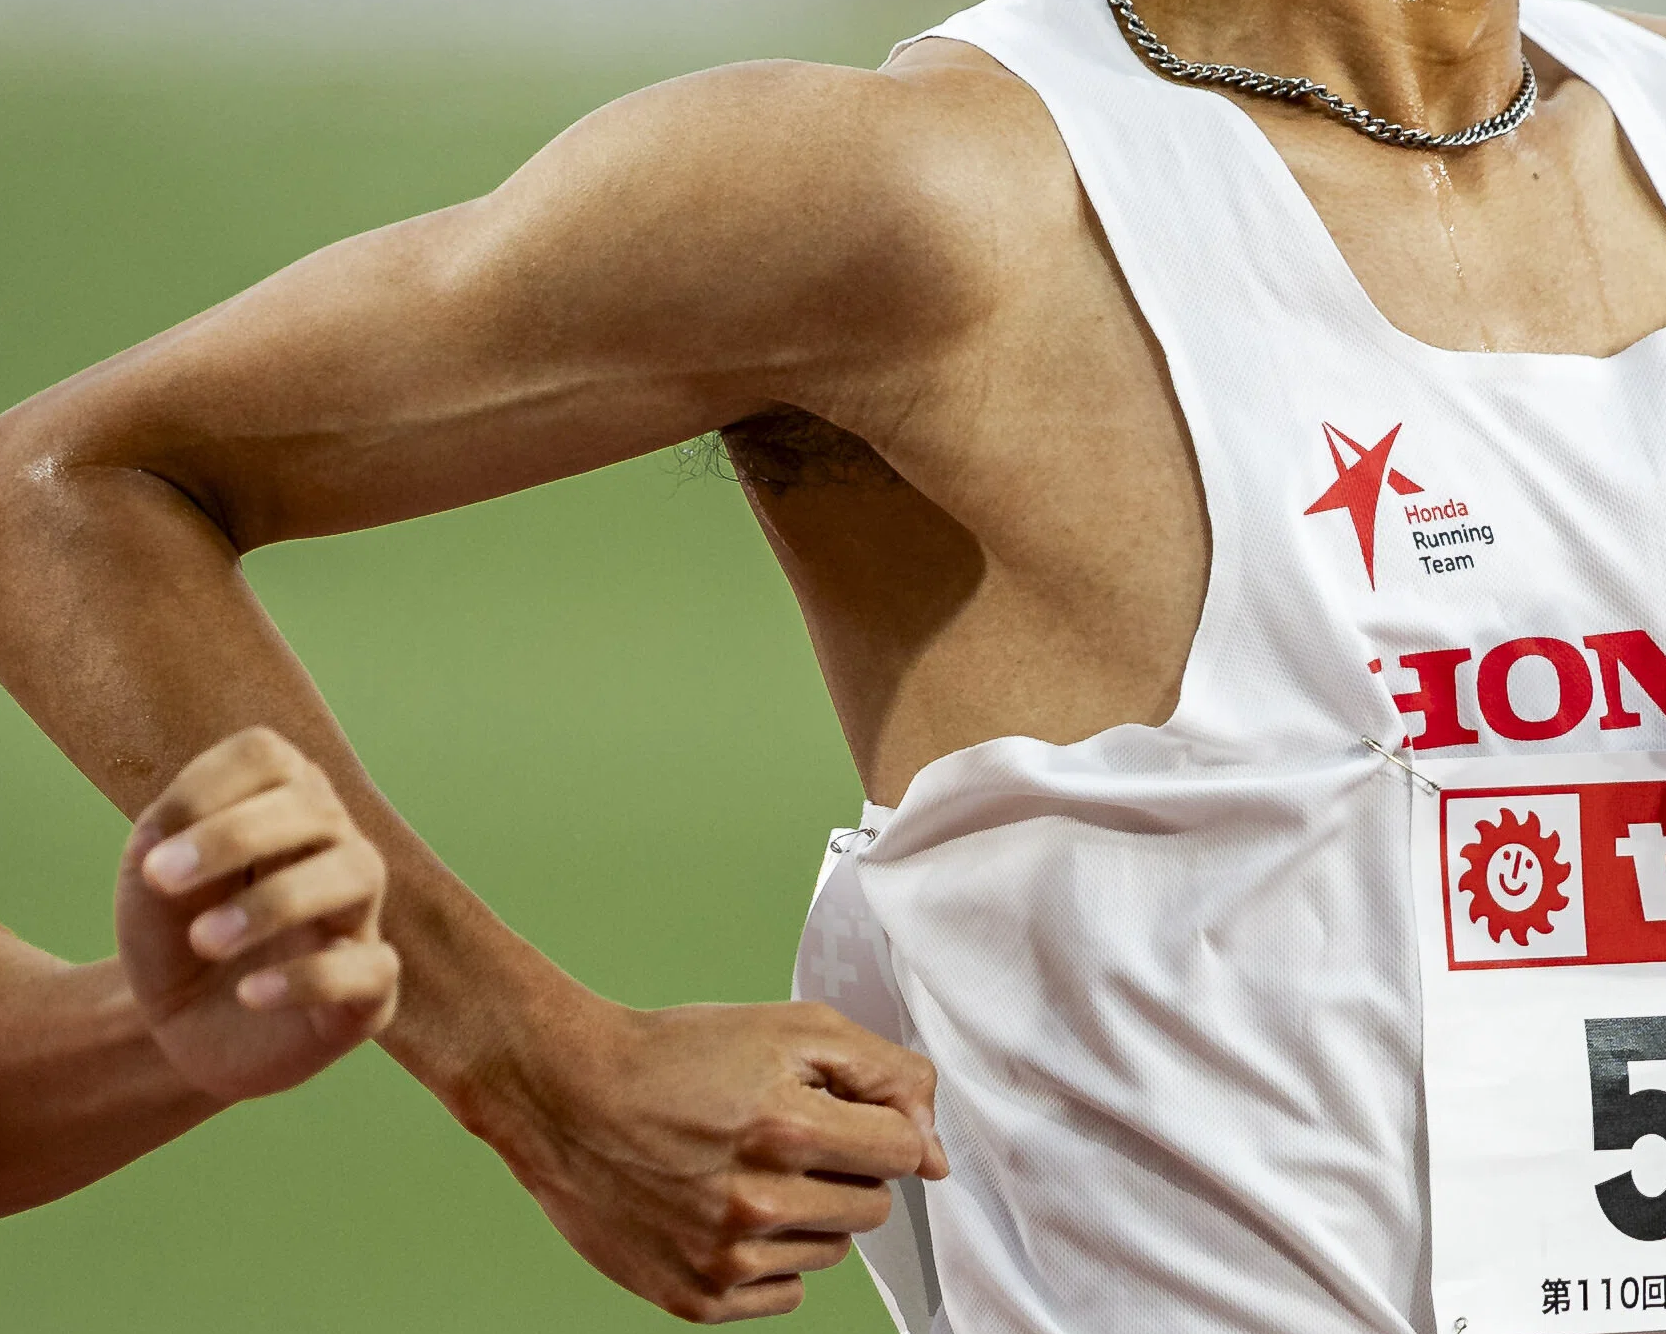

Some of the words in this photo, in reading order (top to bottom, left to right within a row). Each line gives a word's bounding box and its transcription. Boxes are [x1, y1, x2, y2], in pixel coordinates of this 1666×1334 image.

[1404, 498, 1469, 525] Honda
[1412, 523, 1495, 550] Running
[1418, 554, 1475, 575] Team
